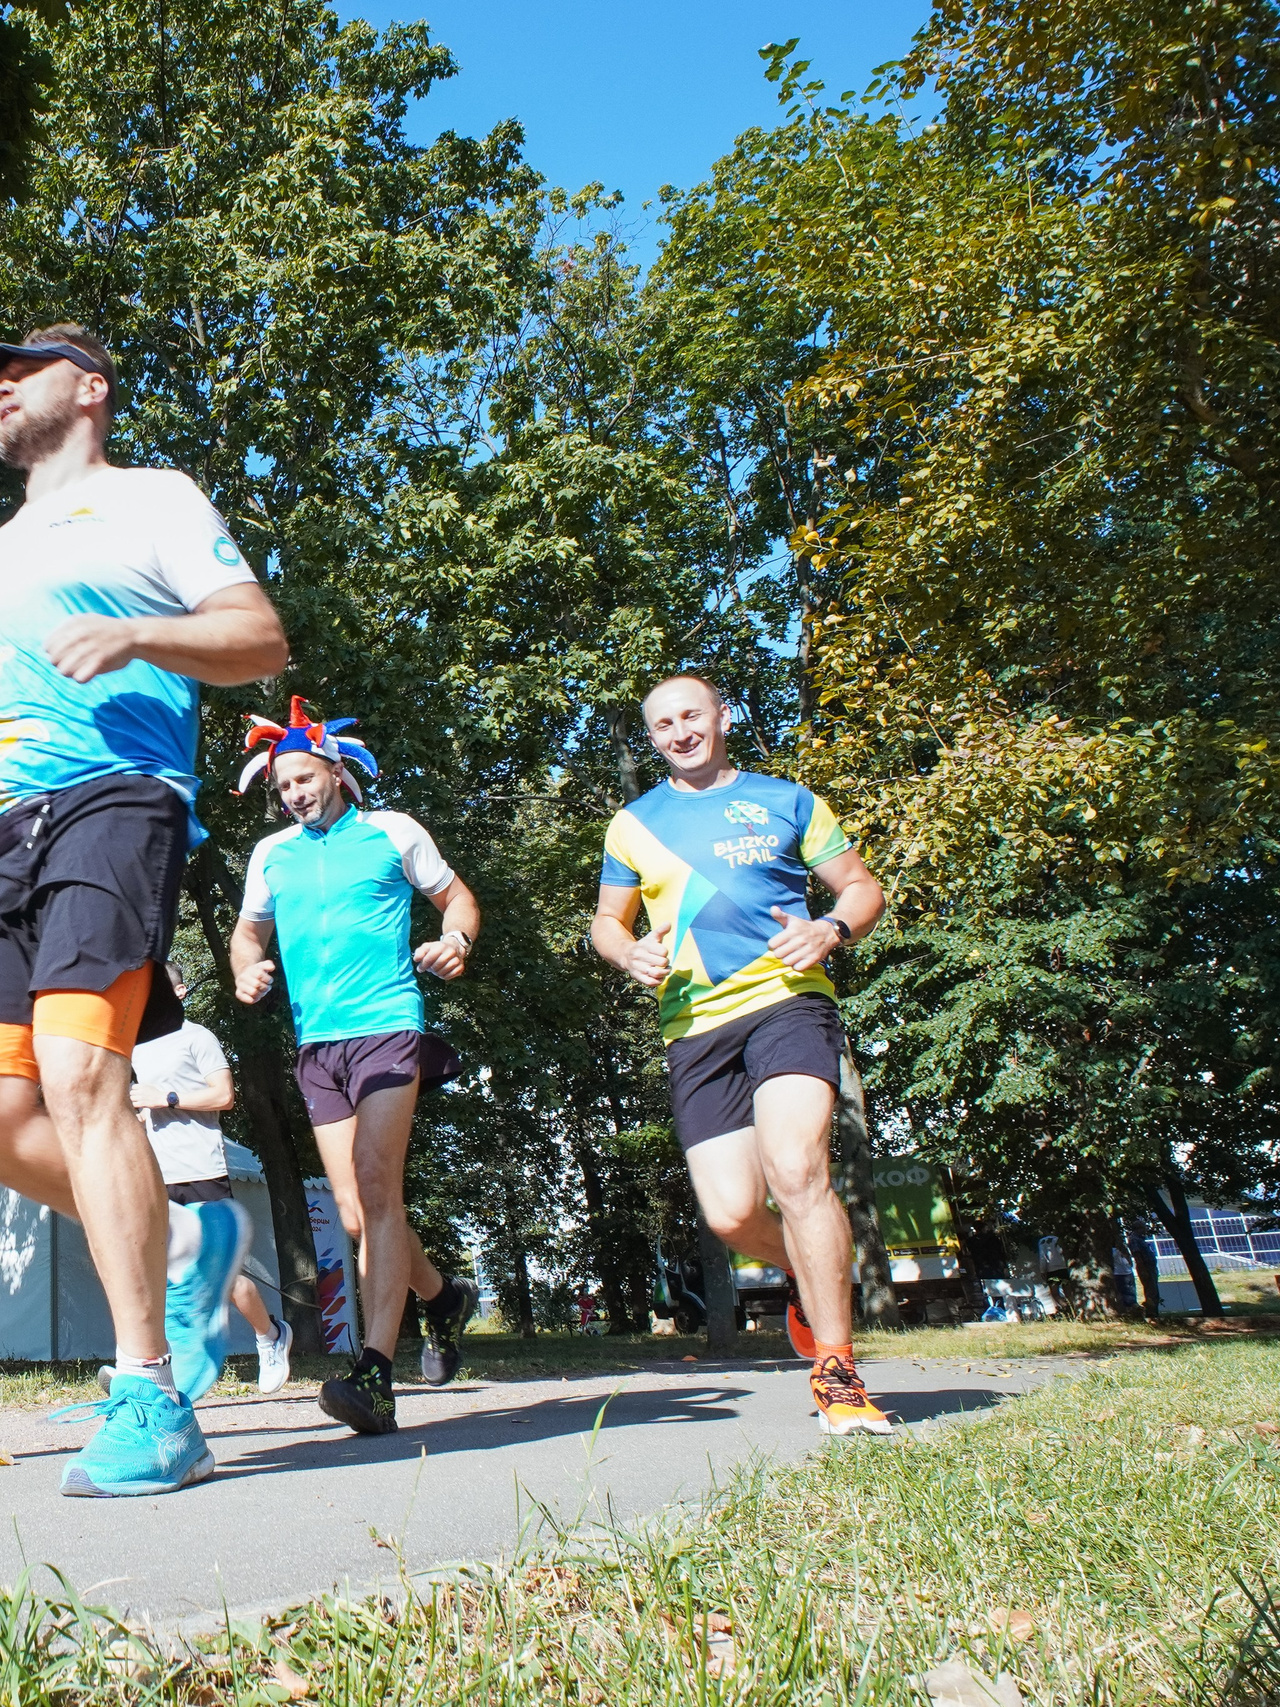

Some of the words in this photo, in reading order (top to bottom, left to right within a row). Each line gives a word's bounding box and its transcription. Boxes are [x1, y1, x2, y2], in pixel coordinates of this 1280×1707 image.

[713, 835, 779, 857] BLIZKO
[722, 848, 778, 869] TRAIL
[872, 1165, 930, 1188] КОФ
[309, 1216, 330, 1225] берцы
